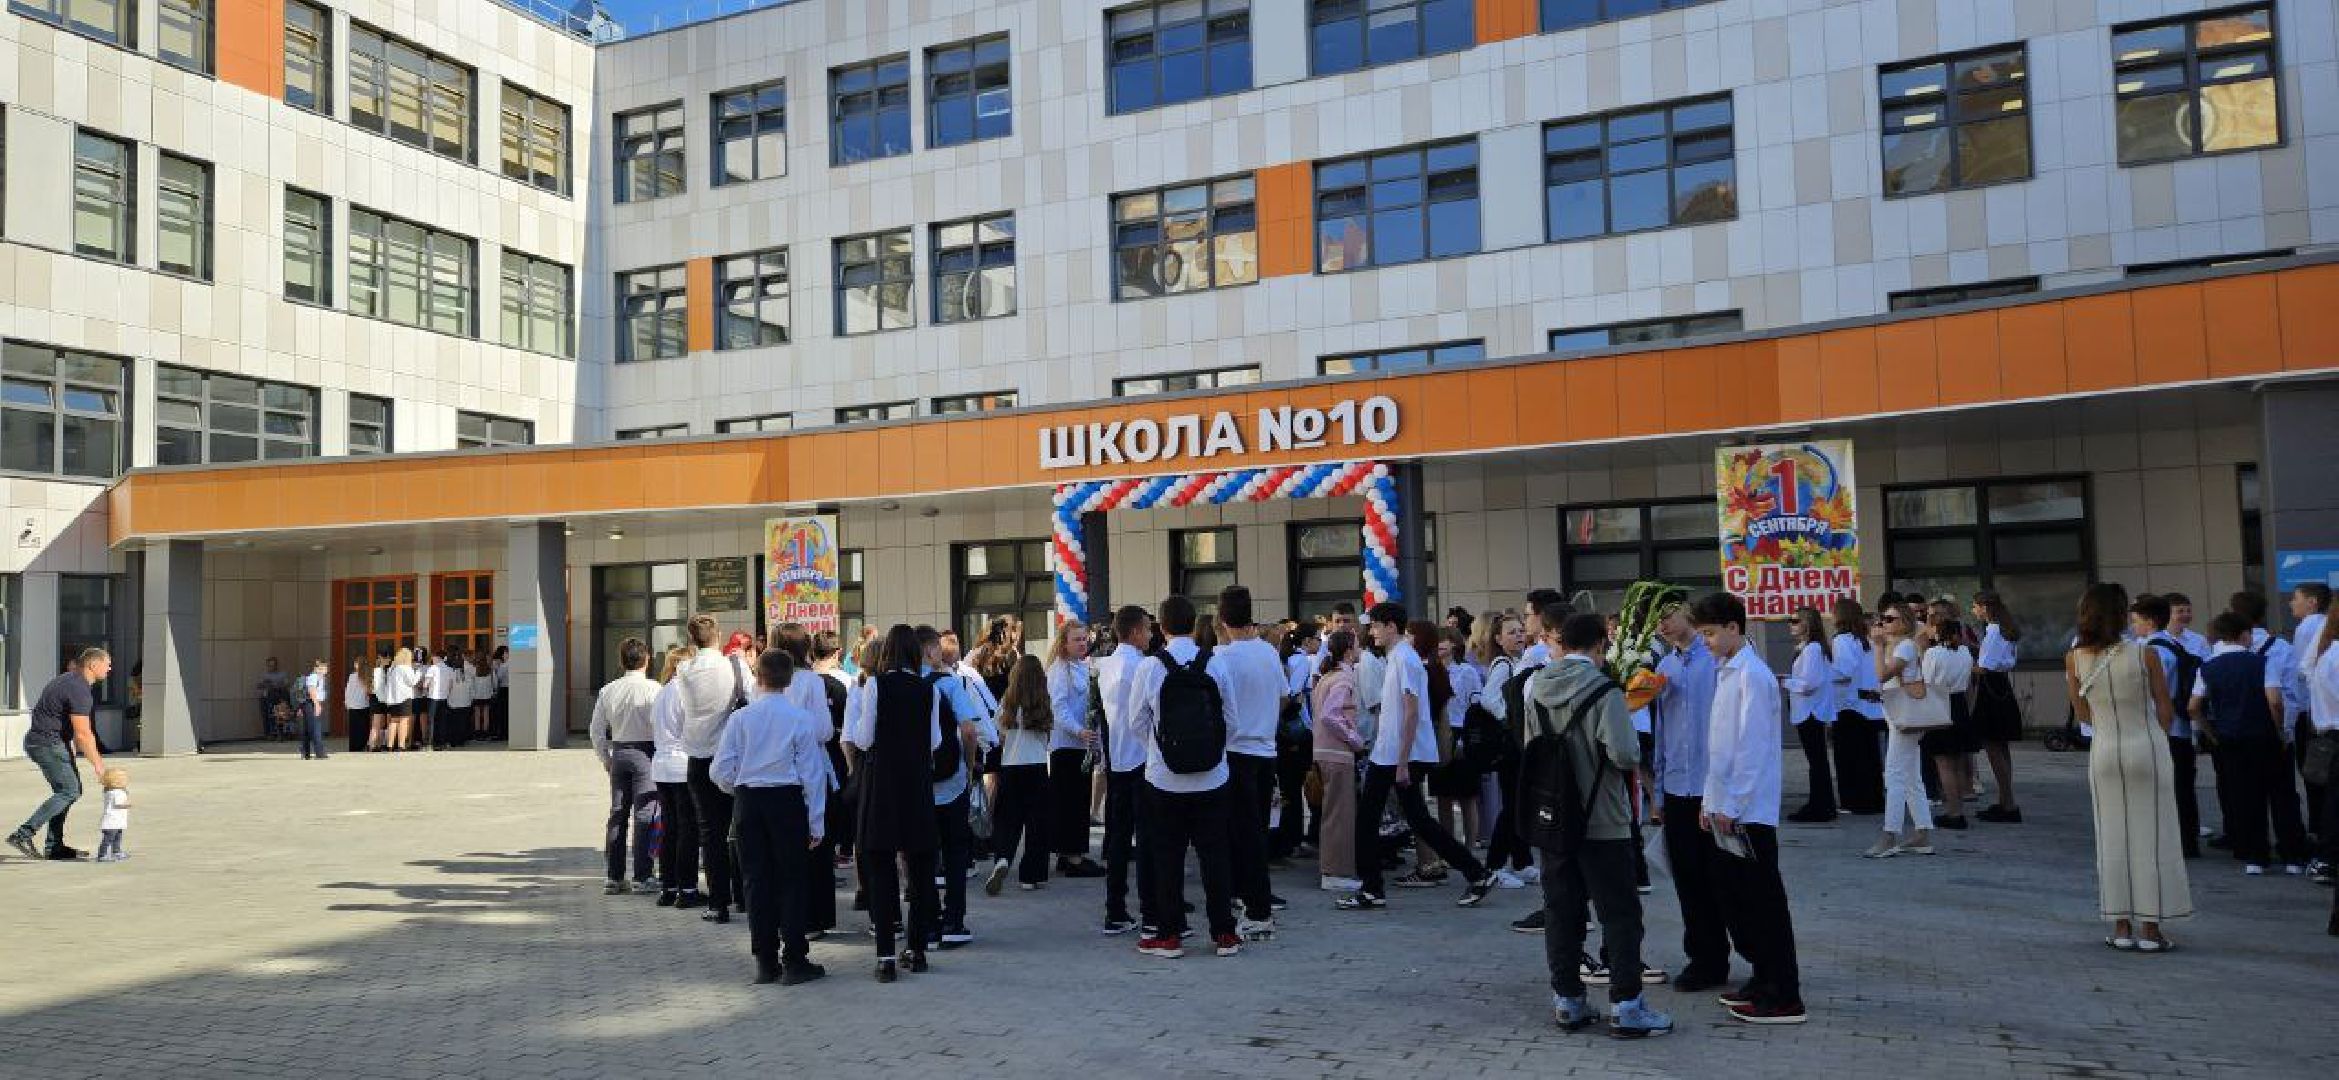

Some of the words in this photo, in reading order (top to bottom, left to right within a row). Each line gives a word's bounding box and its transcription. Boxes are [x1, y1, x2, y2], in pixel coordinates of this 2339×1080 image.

[1039, 411, 1245, 469] ШКОЛА
[1258, 395, 1399, 452] №10
[1770, 459, 1798, 514] 1
[1748, 517, 1829, 538] СЕНТЯБРЯ
[793, 528, 806, 567] 1
[1727, 568, 1746, 591] С
[1758, 567, 1850, 593] Днем
[785, 602, 834, 622] Днем
